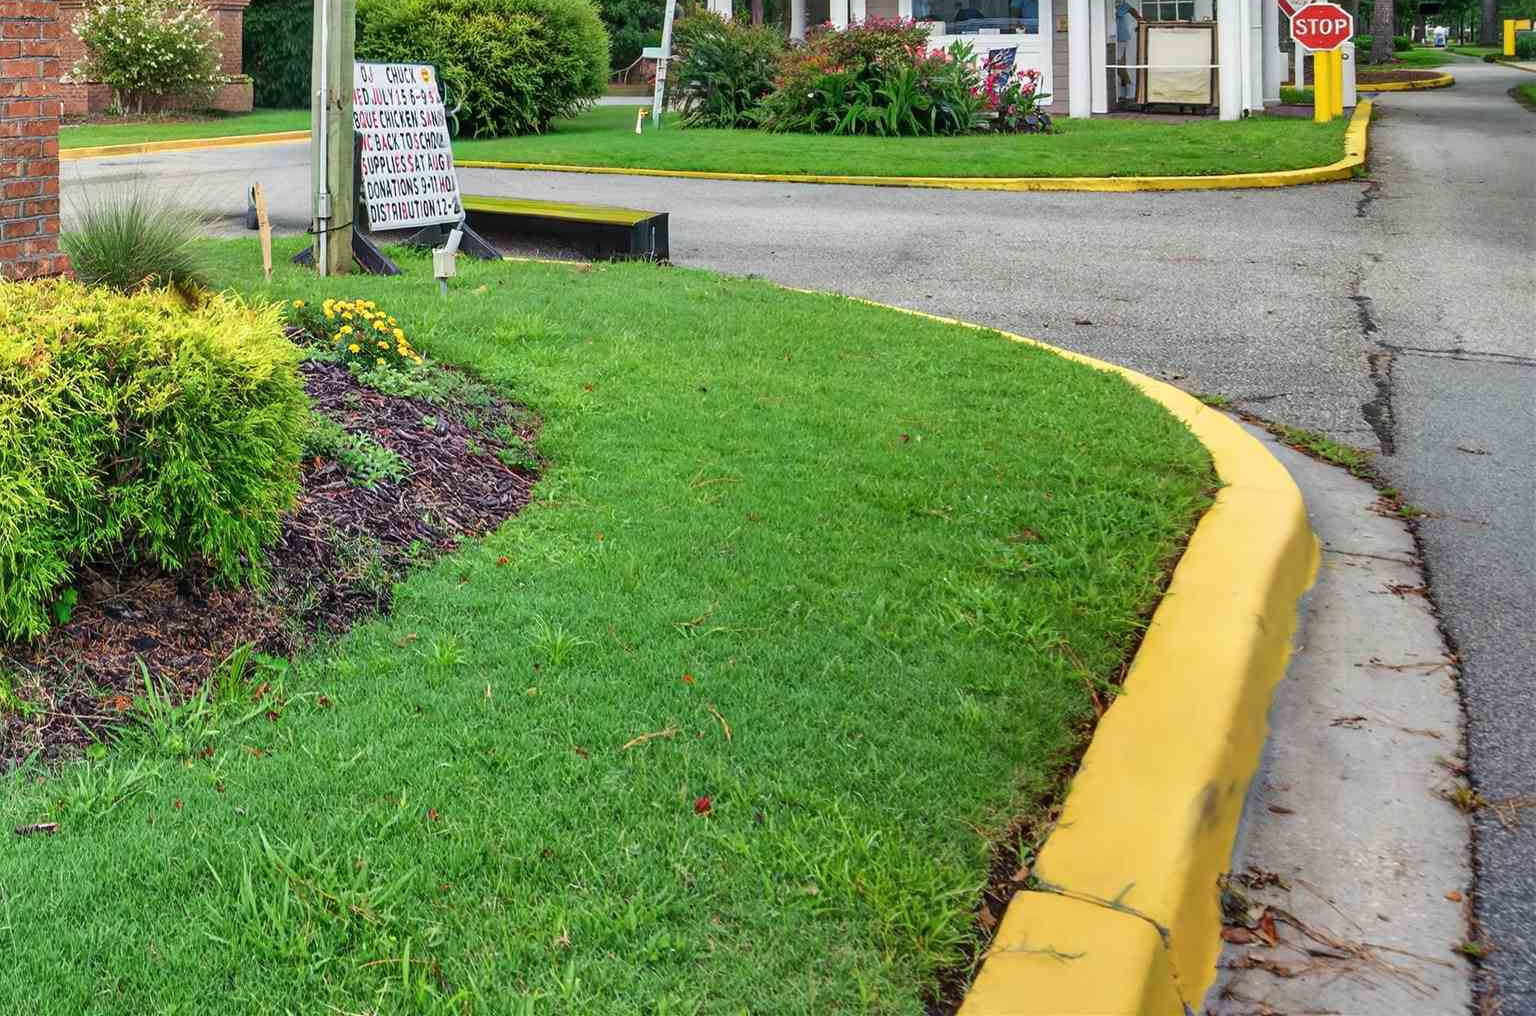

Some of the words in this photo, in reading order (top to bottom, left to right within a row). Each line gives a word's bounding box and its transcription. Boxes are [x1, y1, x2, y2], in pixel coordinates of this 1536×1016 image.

[1295, 18, 1348, 35] STOP
[385, 66, 416, 84] CHUCK
[372, 88, 394, 105] JULY
[395, 88, 407, 105] 15
[379, 110, 419, 129] CHICKEN
[375, 133, 399, 152] BACK
[400, 132, 413, 150] TO
[362, 155, 407, 176] SUPPLIES
[407, 153, 425, 173] SAT
[428, 153, 445, 172] AUG
[367, 177, 419, 200] DONATIONS
[370, 200, 436, 223] DISTRIBUTION
